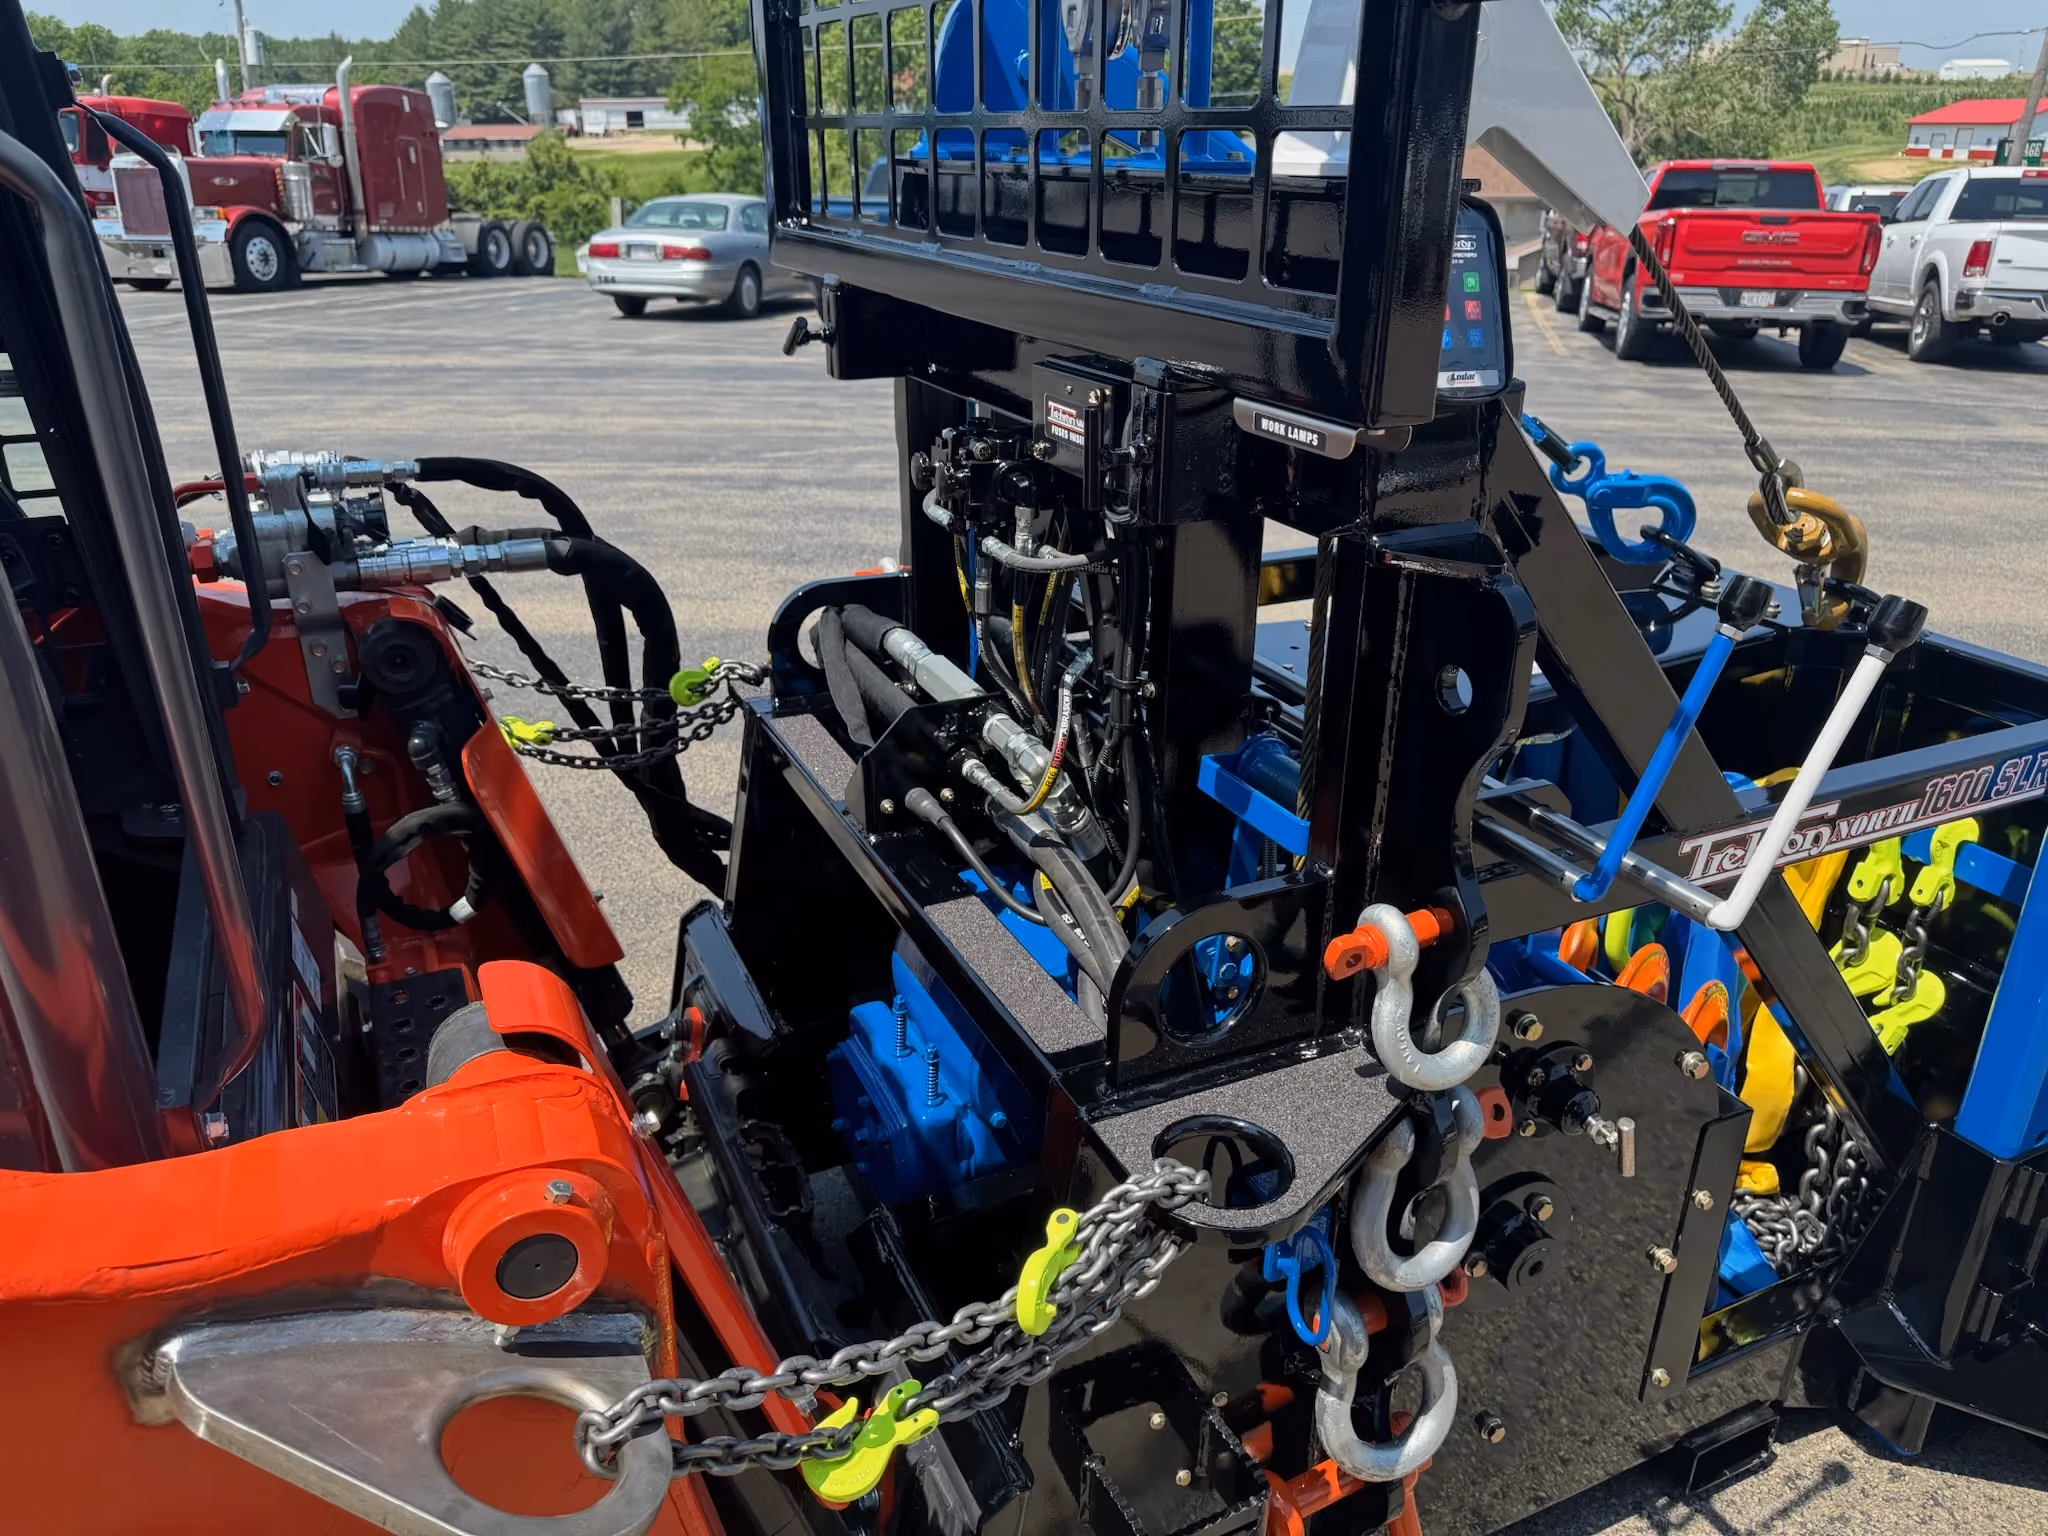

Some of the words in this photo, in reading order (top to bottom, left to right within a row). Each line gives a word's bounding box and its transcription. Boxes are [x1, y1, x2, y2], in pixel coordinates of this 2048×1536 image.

[1741, 229, 1800, 246] GMC
[1261, 417, 1286, 436] WORK
[1287, 426, 1319, 446] LAMPS
[1051, 735, 1067, 768] SUPER
[1832, 799, 1922, 839] NORTH
[1917, 765, 1995, 818] 1600
